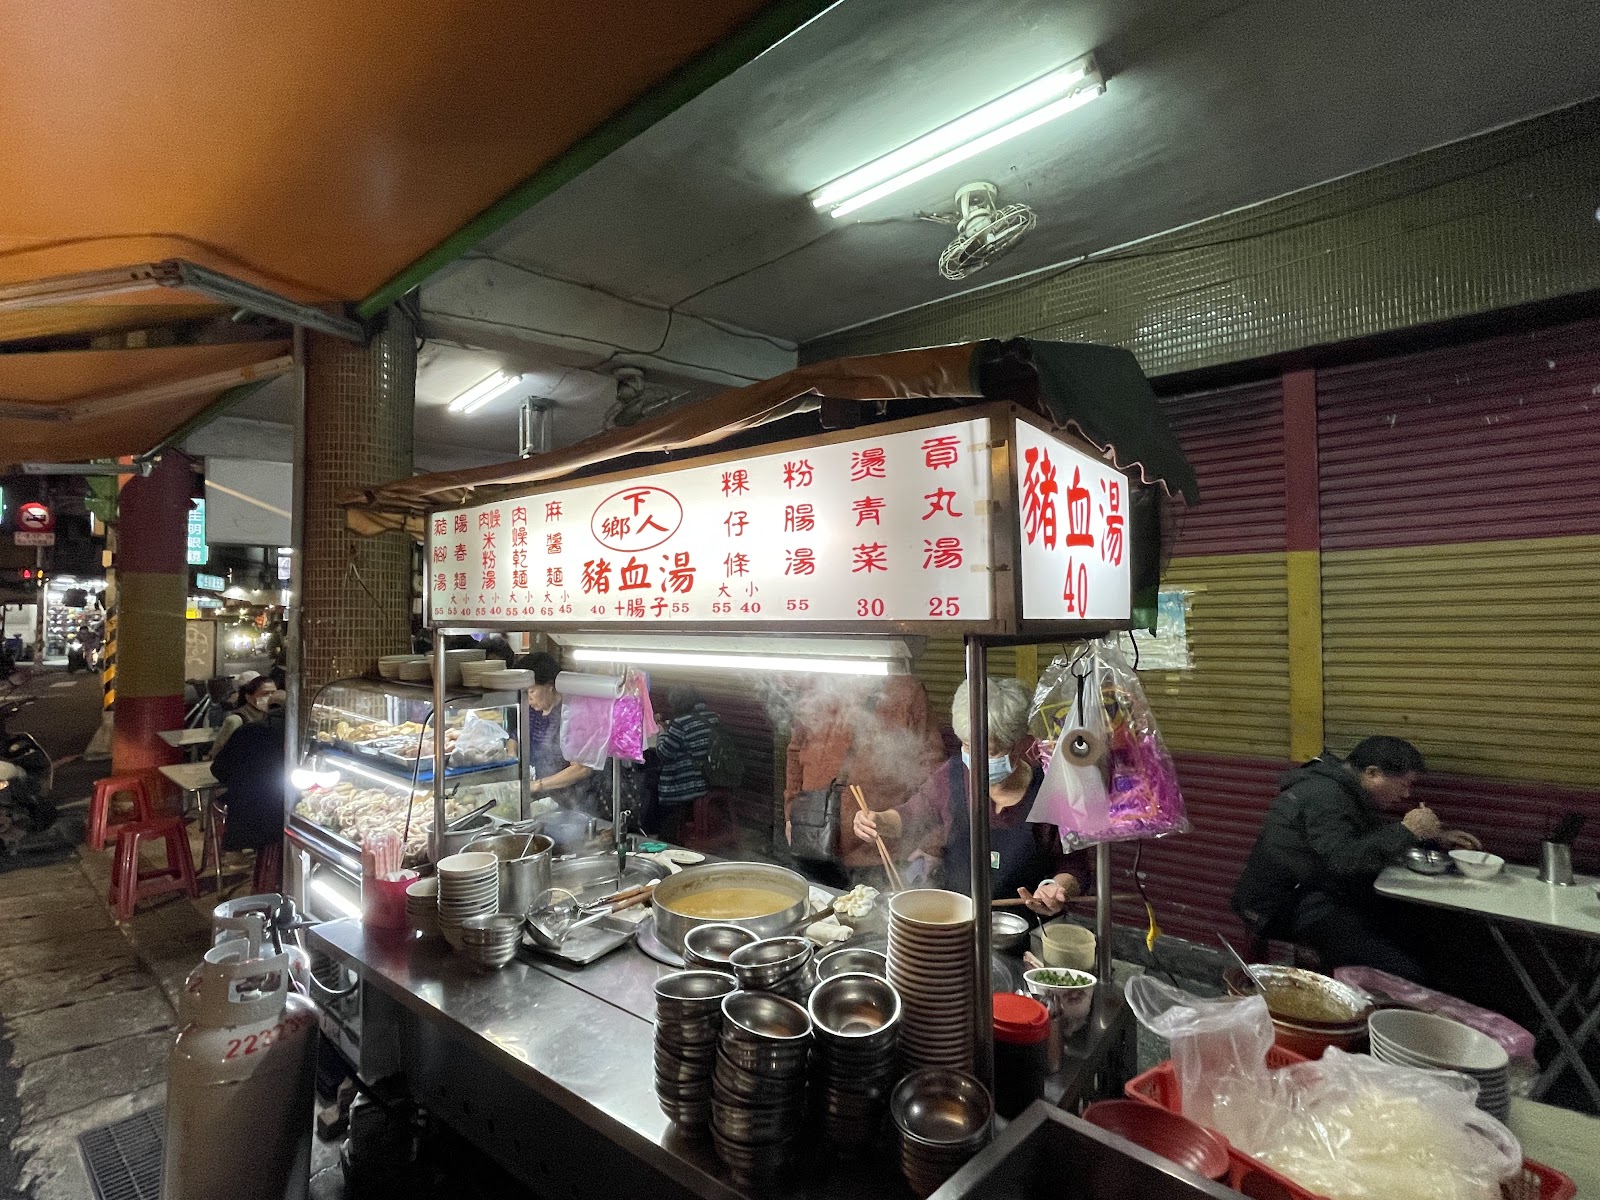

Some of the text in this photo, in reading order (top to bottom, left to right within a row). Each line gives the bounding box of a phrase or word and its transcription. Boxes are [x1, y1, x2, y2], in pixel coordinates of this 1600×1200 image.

[850, 447, 888, 573] 燙青菜
[920, 435, 963, 570] 貢丸湯
[1022, 447, 1125, 568] 豬血湯
[721, 469, 750, 576] 粿仔條
[784, 459, 815, 575] 粉腸湯
[454, 513, 468, 590] 陽春麵
[512, 507, 527, 588] 肉燥乾麵
[545, 501, 563, 586] 麻醬麵
[433, 518, 447, 591] 豬腳湯
[580, 551, 697, 595] 豬血湯
[510, 591, 517, 603] 大
[544, 591, 552, 603] 大
[718, 581, 759, 598] 大 小
[1063, 556, 1088, 619] 40
[451, 594, 457, 604] 大
[479, 593, 484, 603] 大
[786, 599, 809, 611] 55
[857, 597, 885, 618] 30
[929, 596, 960, 617] 25
[434, 607, 444, 615] 55
[448, 606, 471, 616] 55 40
[475, 606, 501, 616] 55 40
[506, 606, 535, 616] 55 40
[541, 604, 572, 616] 65 45
[590, 605, 606, 615] 40
[712, 602, 761, 614] 55 40
